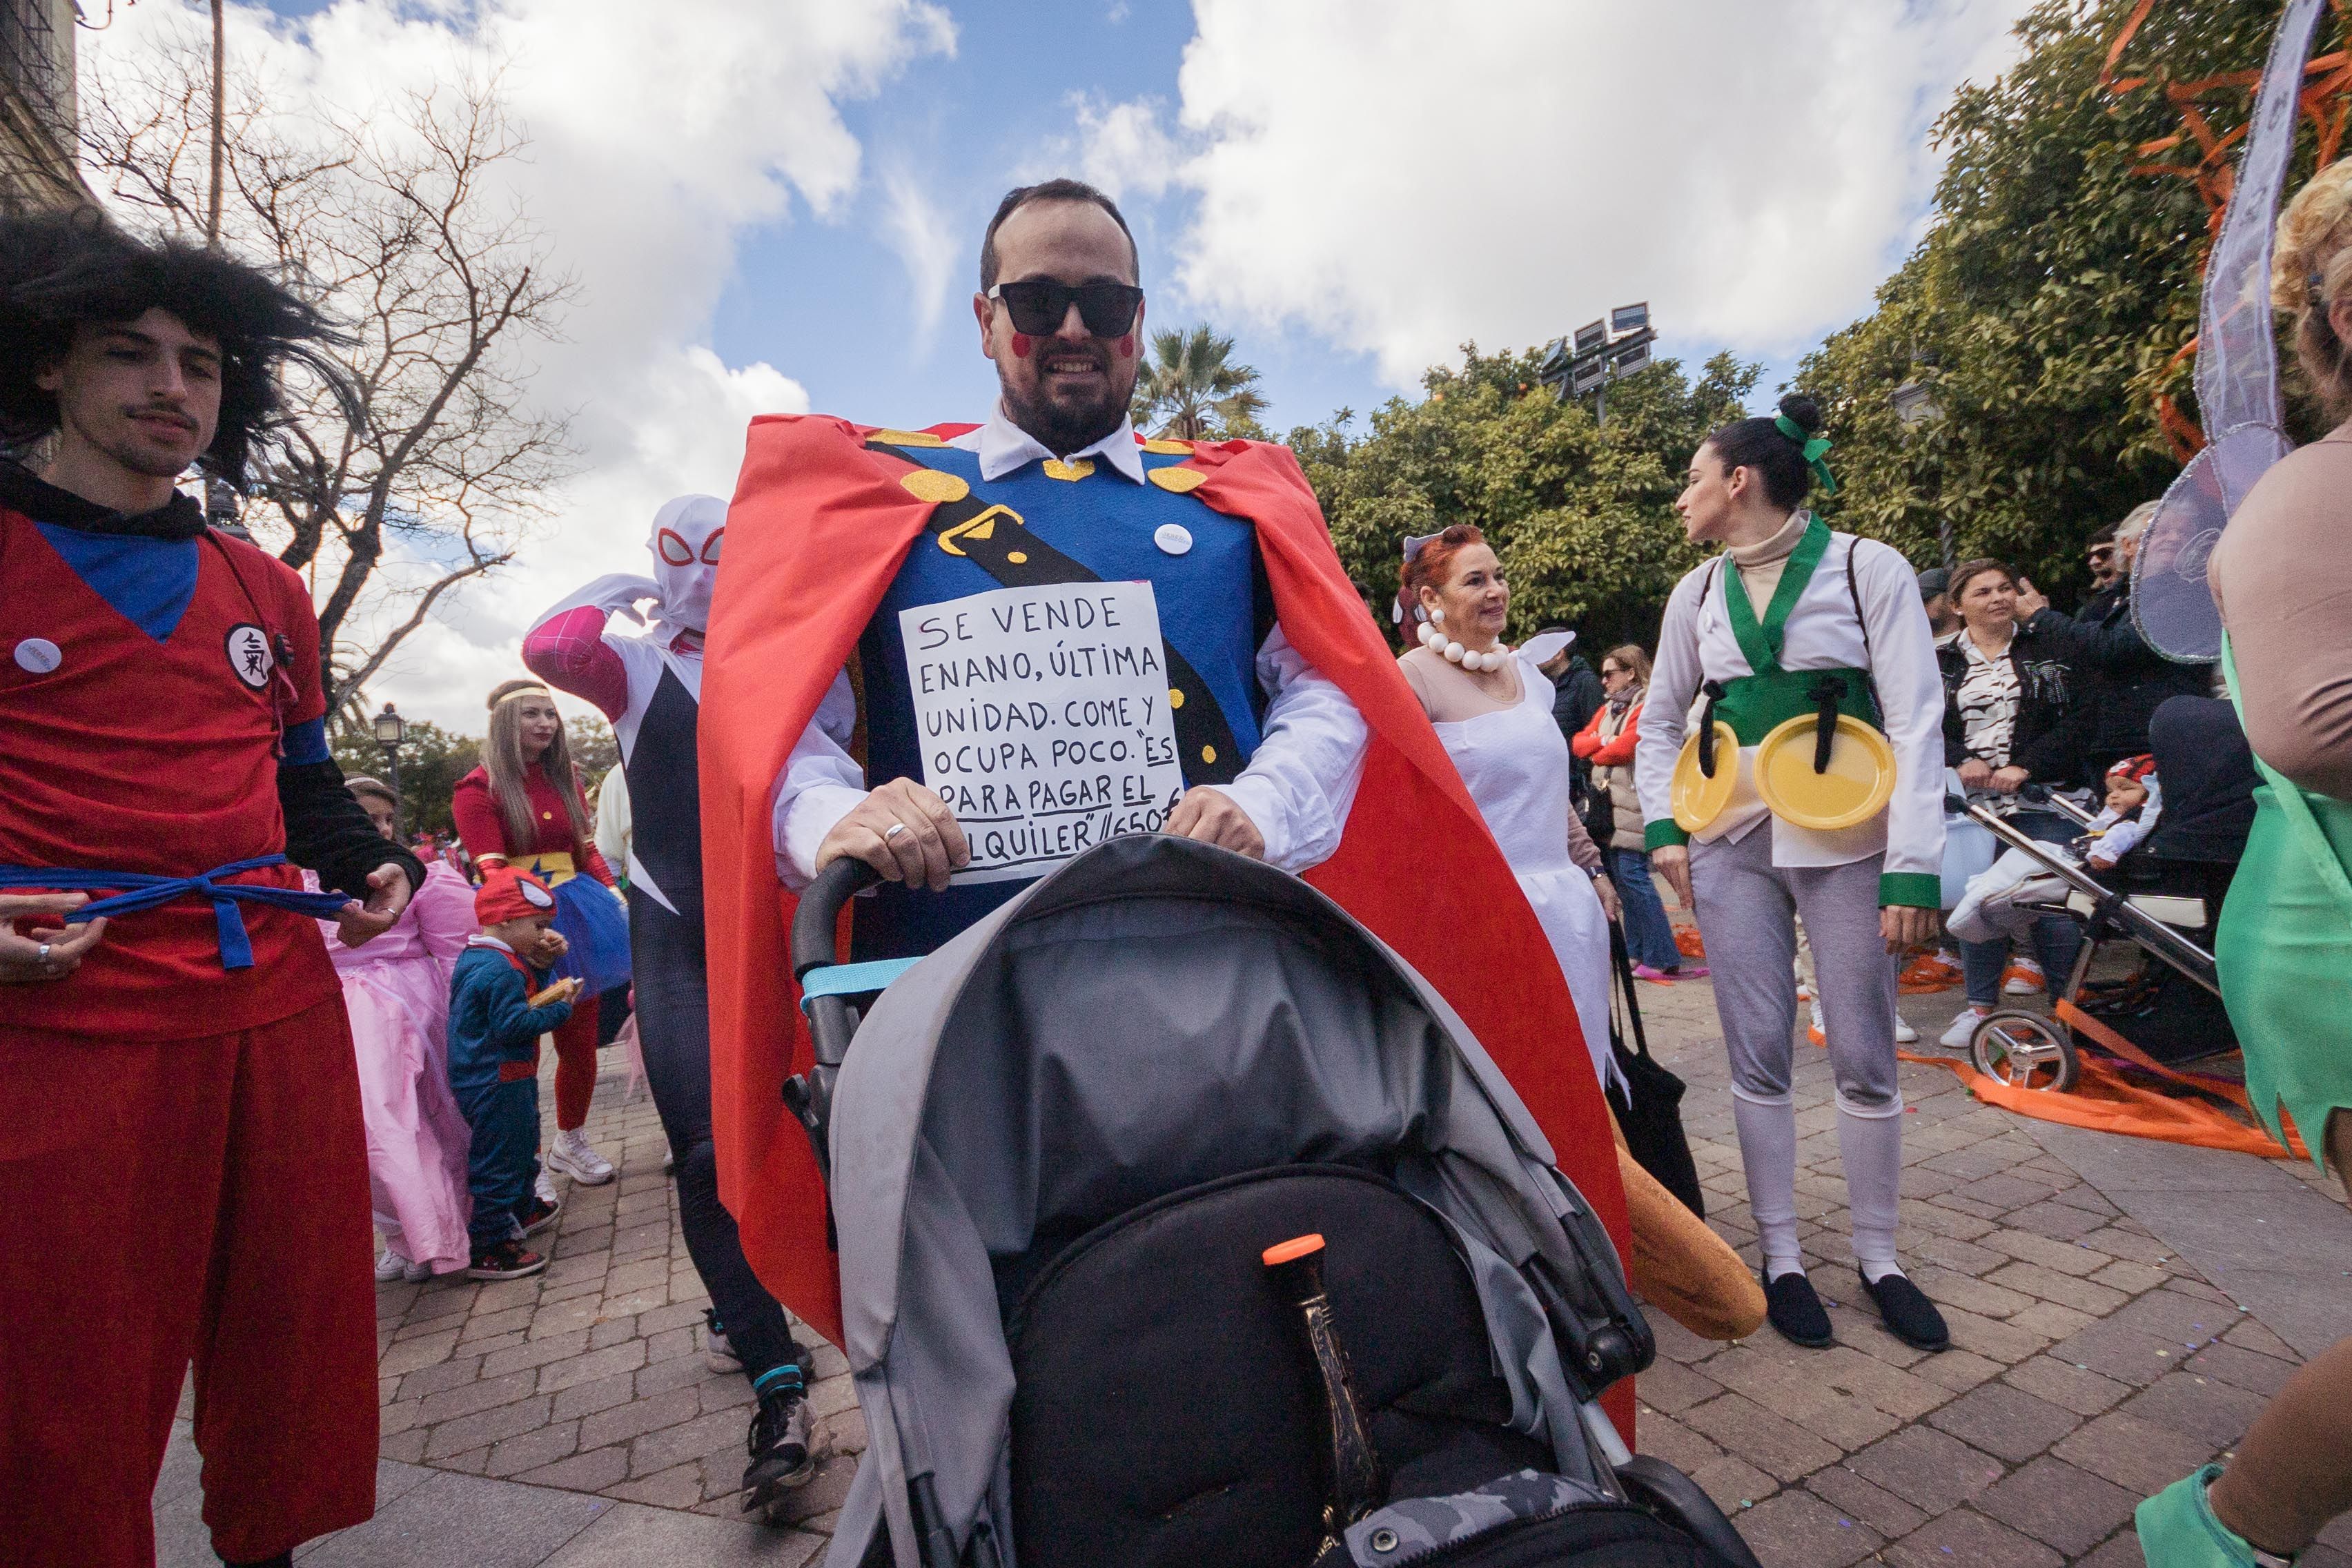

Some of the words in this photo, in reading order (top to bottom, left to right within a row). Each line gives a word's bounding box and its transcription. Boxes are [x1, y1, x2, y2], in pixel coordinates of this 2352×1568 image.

[919, 613, 973, 650] SE
[991, 597, 1121, 633] VENDE
[920, 652, 1043, 694] ENANO,
[1064, 697, 1133, 727] COME
[1141, 696, 1154, 725] Y
[934, 742, 1038, 774] OCUPA
[1052, 739, 1135, 767] POCO.
[1028, 774, 1112, 810] PAGAR
[1122, 774, 1156, 801] EL
[968, 812, 1095, 861] LQUILER"
